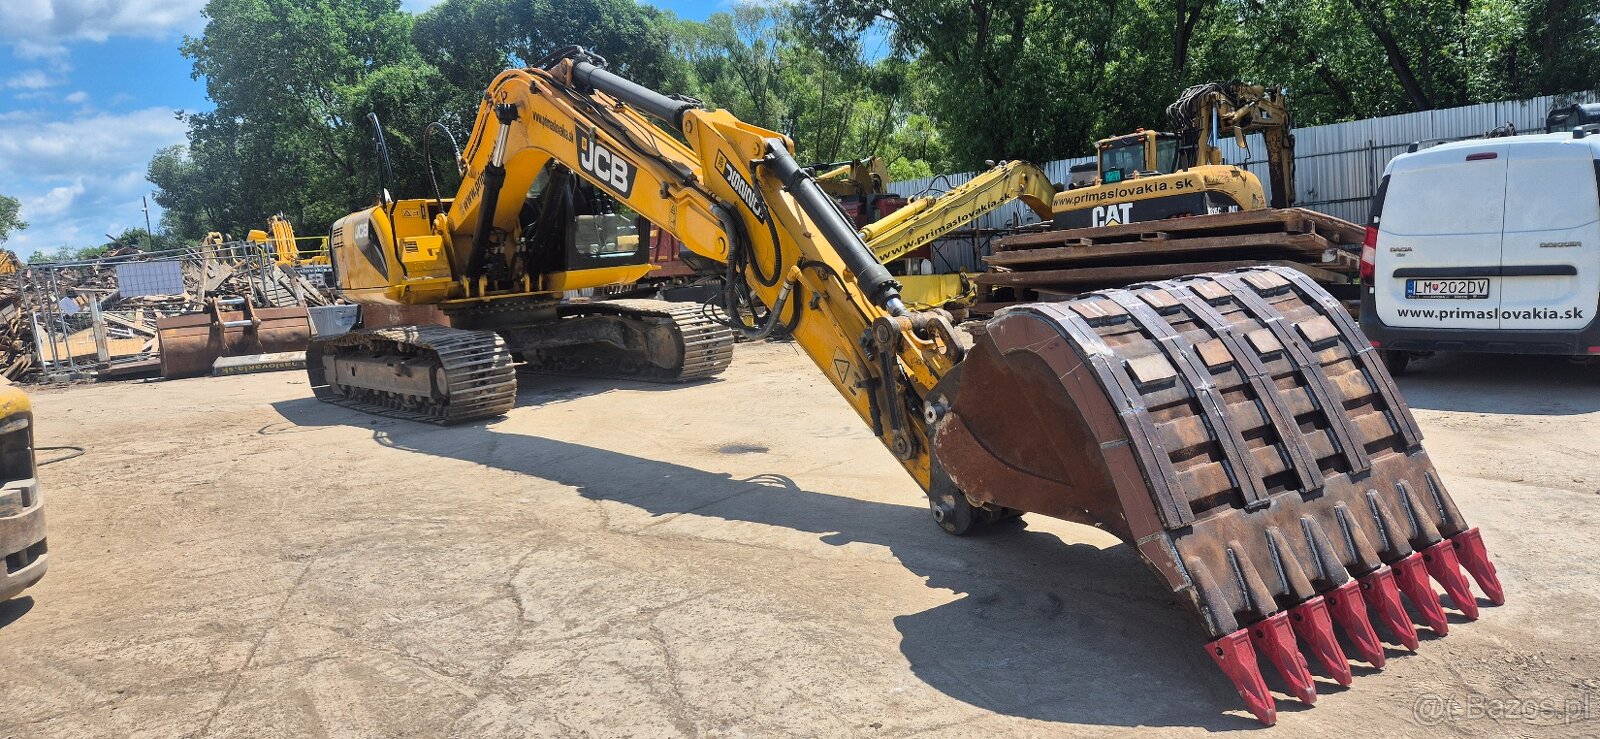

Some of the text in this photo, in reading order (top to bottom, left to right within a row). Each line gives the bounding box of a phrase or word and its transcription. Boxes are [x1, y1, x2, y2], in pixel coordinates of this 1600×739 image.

[581, 141, 628, 193] JCB
[1052, 178, 1193, 207] www.primaslovakia.sk
[879, 192, 1011, 261] www.primaslovakia.sk
[1092, 203, 1134, 228] CAT
[355, 223, 369, 239] JCB
[1415, 280, 1486, 294] LM 202DV
[1397, 307, 1584, 321] www.primaslovakia.sk
